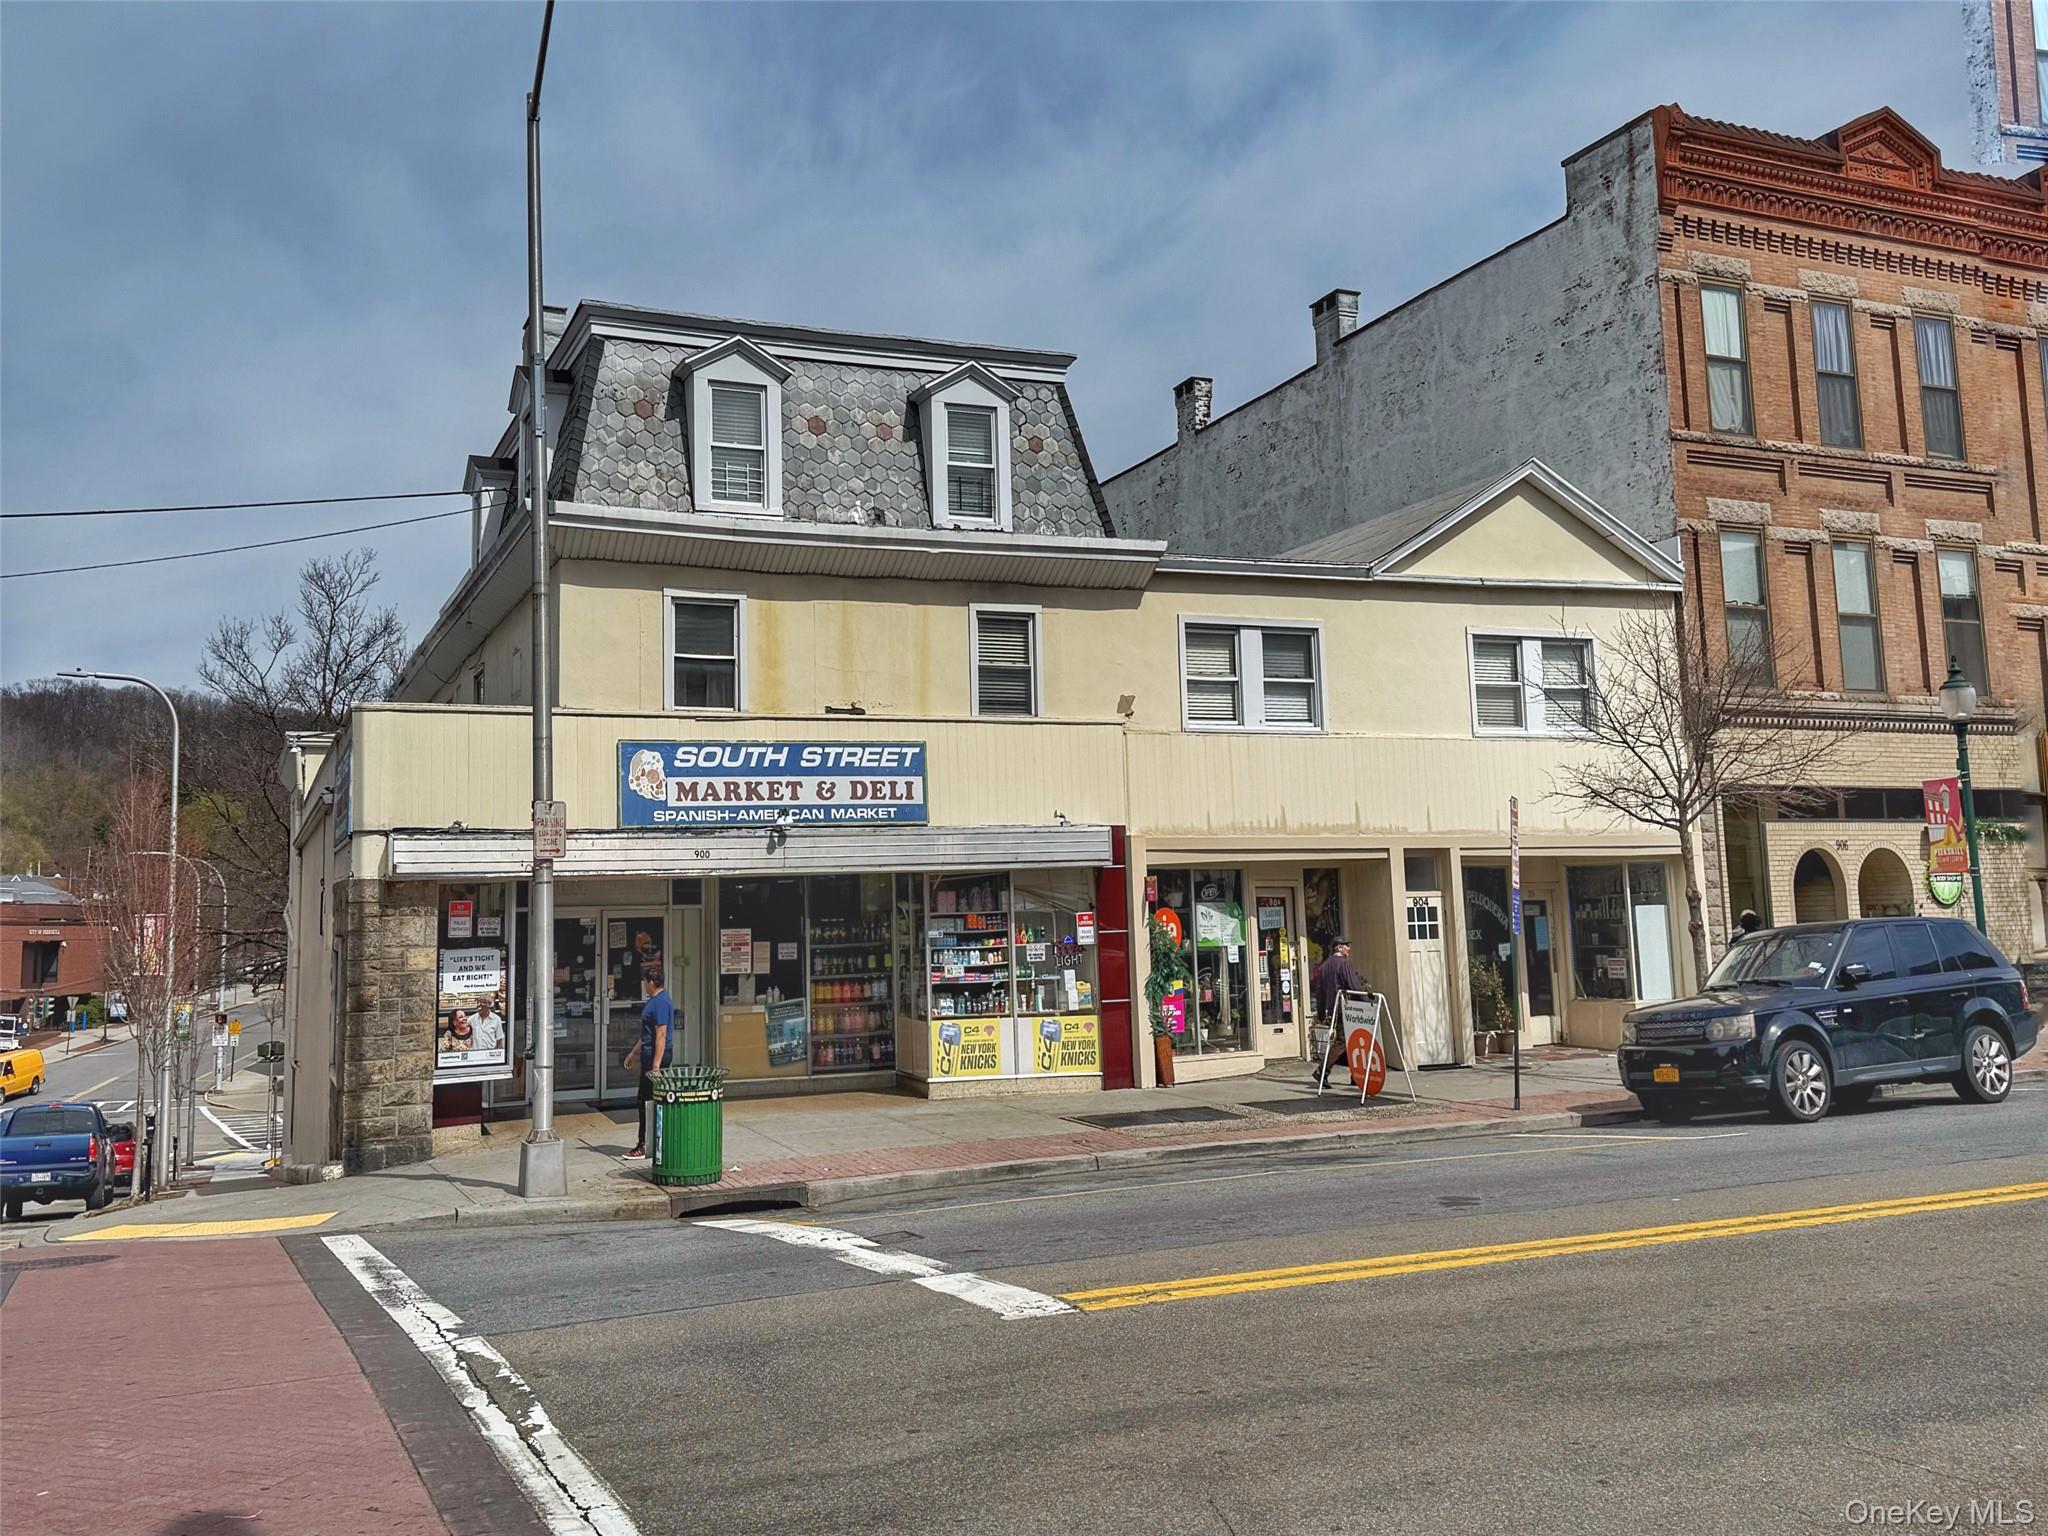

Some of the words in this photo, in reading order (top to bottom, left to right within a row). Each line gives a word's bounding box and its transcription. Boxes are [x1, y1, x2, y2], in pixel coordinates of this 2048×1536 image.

[674, 747, 789, 768] SOUTH
[800, 747, 920, 768] STREET
[675, 781, 803, 801] MARKET
[816, 781, 836, 800] &
[849, 781, 914, 800] DELI
[831, 808, 897, 819] MARKET
[694, 850, 710, 859] 900
[1202, 888, 1217, 897] OPEN
[1412, 897, 1429, 907] 904
[1465, 889, 1509, 931] PELUQUERIA
[1055, 954, 1083, 967] LIGHT
[1345, 1013, 1376, 1026] Worldwid
[964, 1026, 980, 1034] C4
[1064, 1023, 1080, 1031] C4
[961, 1044, 977, 1055] NEW
[977, 1042, 997, 1054] YORK
[1061, 1040, 1077, 1051] NEW
[1077, 1039, 1096, 1050] YORK
[1060, 1051, 1097, 1066] KNICKS
[1352, 1037, 1381, 1073] ria
[960, 1054, 997, 1070] KNICKS
